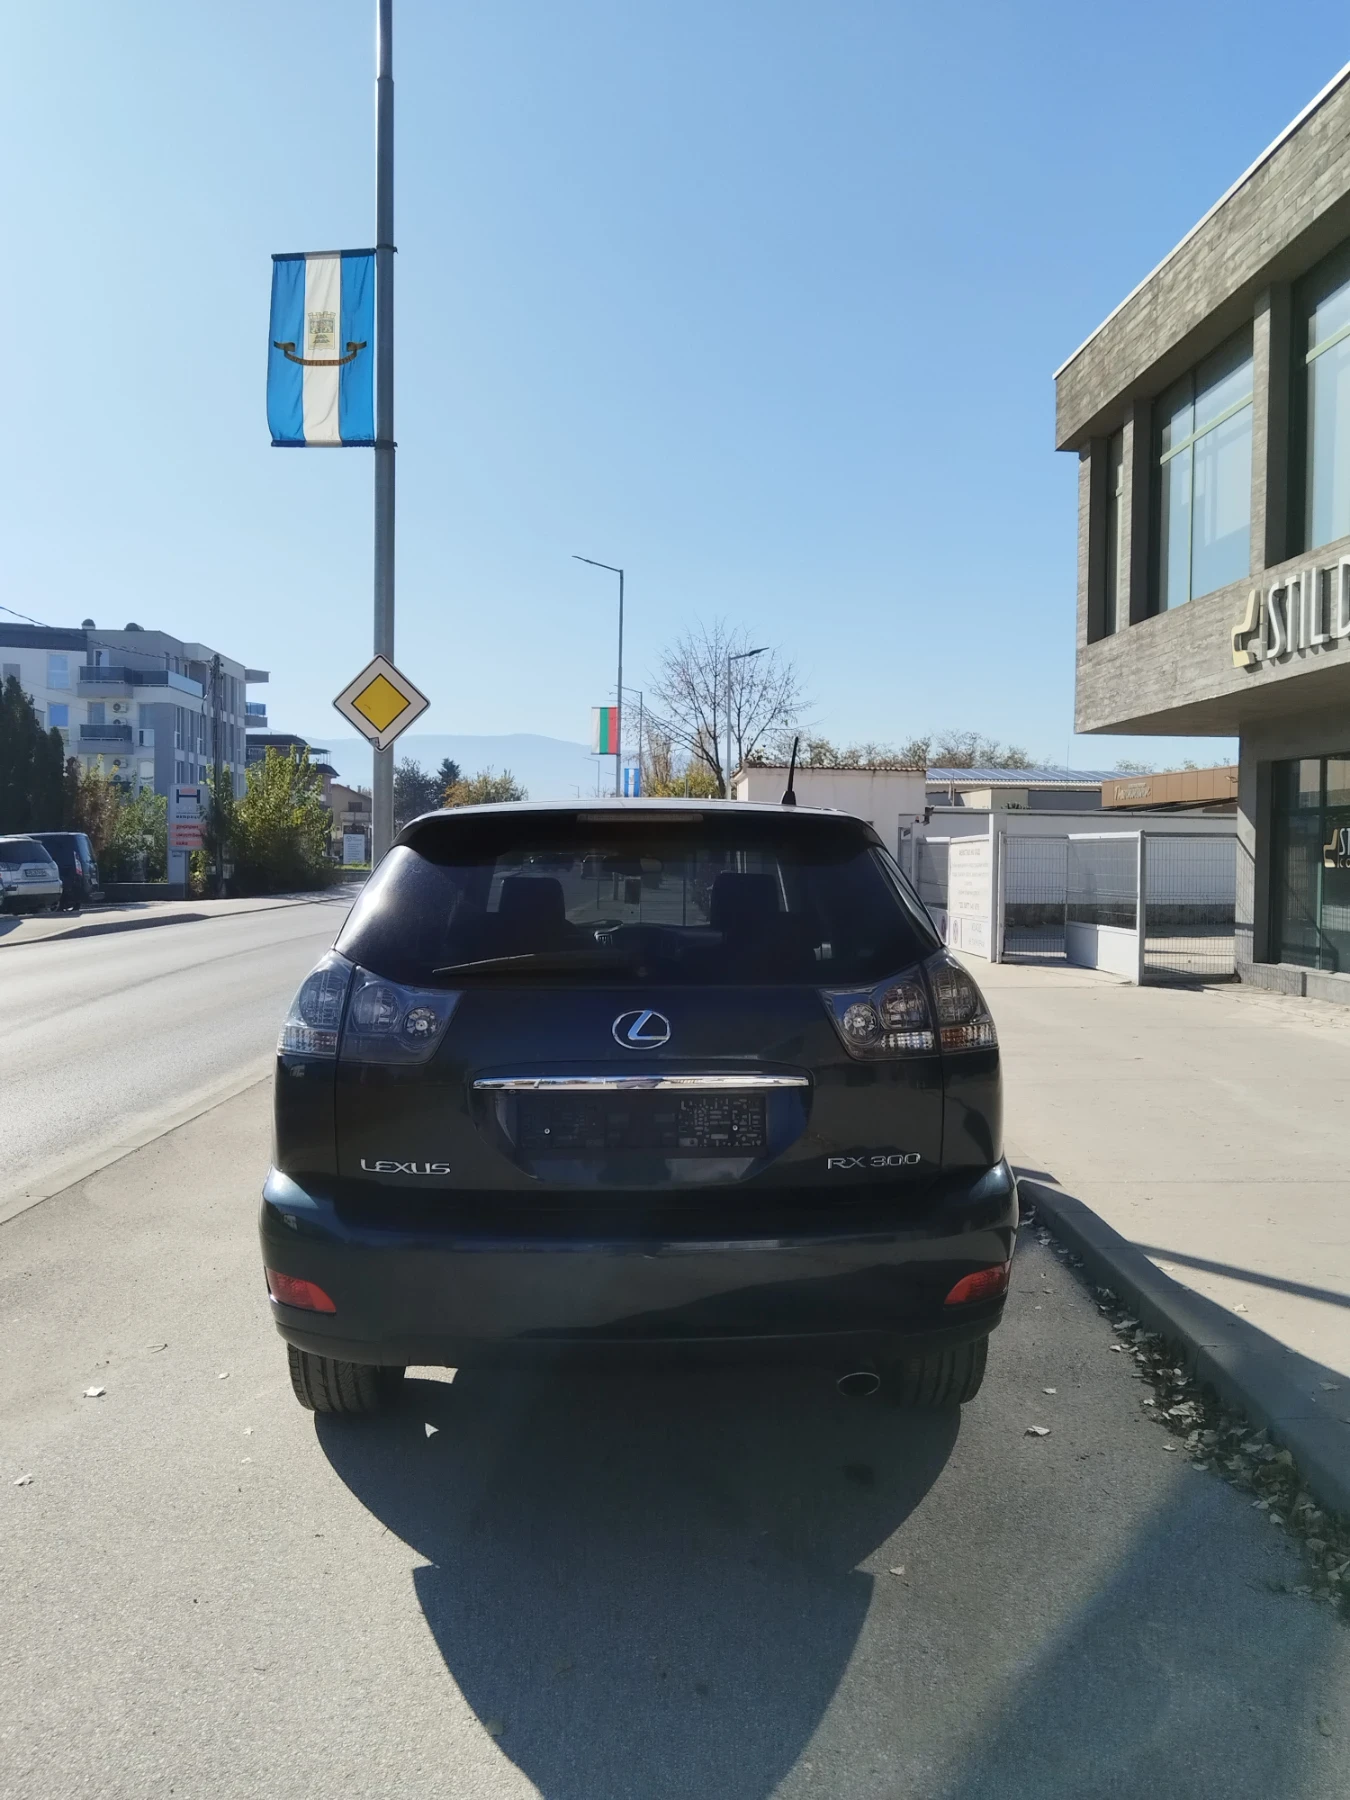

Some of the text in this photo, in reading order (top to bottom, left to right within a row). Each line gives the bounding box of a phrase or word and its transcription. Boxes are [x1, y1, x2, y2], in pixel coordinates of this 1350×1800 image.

[360, 1158, 451, 1175] LEXUS
[827, 1152, 921, 1170] RX 300
